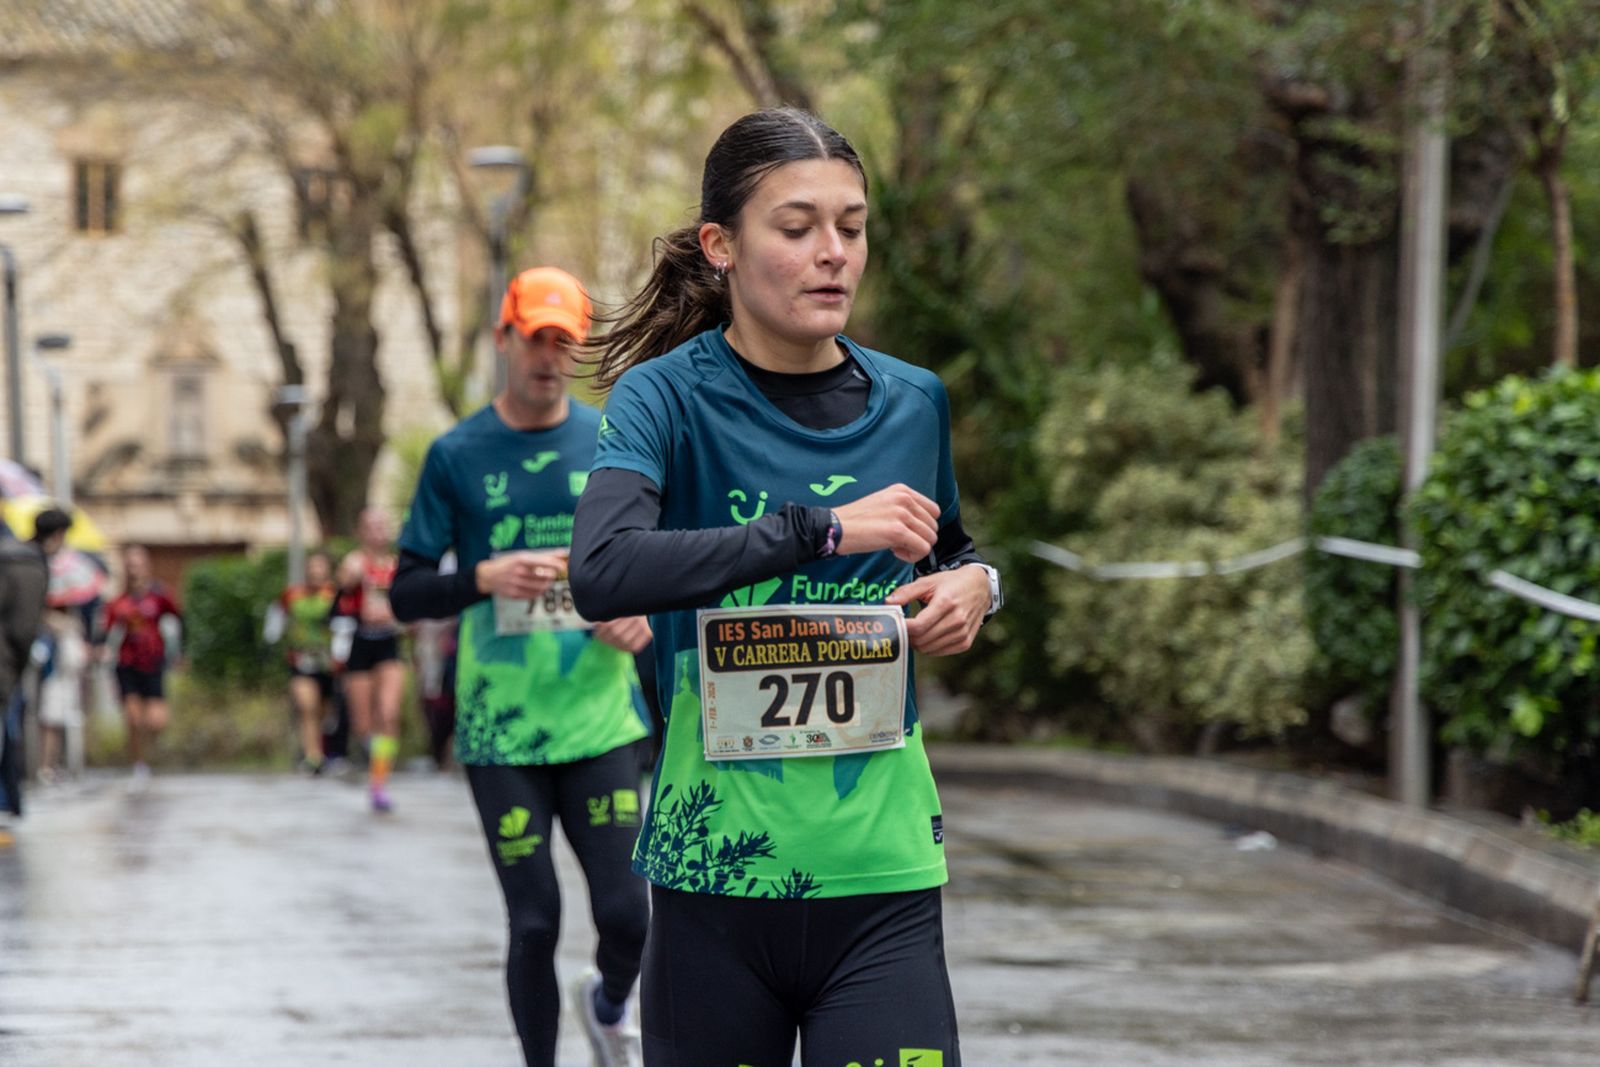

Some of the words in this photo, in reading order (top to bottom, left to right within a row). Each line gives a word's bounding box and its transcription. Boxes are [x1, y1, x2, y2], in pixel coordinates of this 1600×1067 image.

[718, 622, 746, 641] IES
[751, 621, 784, 640] San
[789, 618, 831, 638] Juan
[835, 616, 884, 635] Bosco
[714, 646, 727, 667] V
[732, 641, 812, 666] CARRERA
[816, 638, 893, 662] POPULAR
[758, 671, 855, 728] 270
